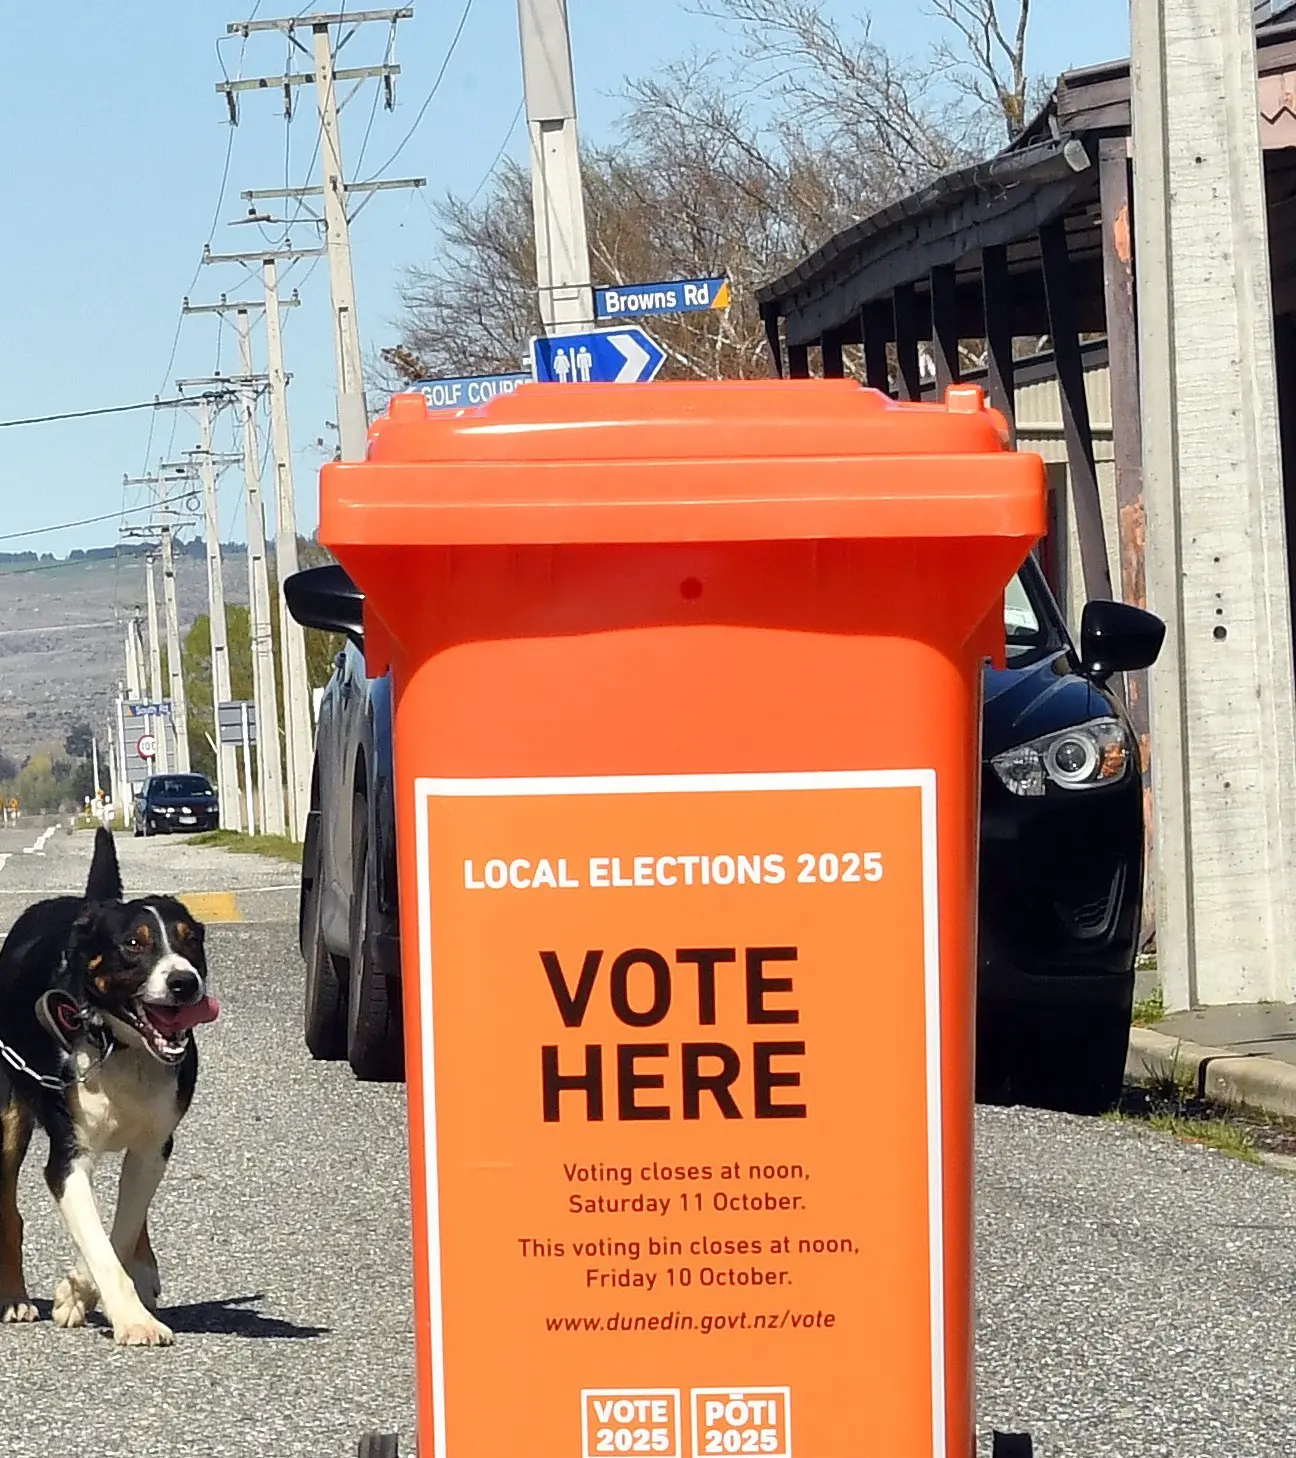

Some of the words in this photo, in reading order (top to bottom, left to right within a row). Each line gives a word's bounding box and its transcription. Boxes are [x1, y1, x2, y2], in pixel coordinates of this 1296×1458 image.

[605, 291, 676, 313] Browns
[684, 284, 709, 305] Rd
[421, 384, 461, 406] GOLF
[464, 858, 580, 889] LOCAL
[589, 854, 786, 888] ELECTIONS
[797, 852, 883, 883] 2025
[539, 946, 800, 1028] VOTE
[542, 1041, 807, 1123] HERE
[563, 1162, 632, 1186] Voting
[640, 1161, 713, 1181] closes
[720, 1161, 741, 1180] at
[749, 1164, 810, 1182] noon,
[569, 1193, 671, 1217] Saturday
[679, 1192, 702, 1212] 11
[713, 1191, 806, 1212] October.
[517, 1238, 565, 1258] This
[572, 1237, 641, 1261] voting
[648, 1236, 682, 1256] bin
[689, 1235, 763, 1255] closes
[769, 1236, 791, 1254] at
[798, 1238, 859, 1256] noon,
[586, 1268, 658, 1292] Friday
[666, 1267, 692, 1287] 10
[699, 1266, 792, 1287] October.
[545, 1310, 836, 1335] www.dunedin.govt.nz/vote
[593, 1400, 669, 1424] VOTE
[705, 1393, 777, 1427] PŌTI
[596, 1428, 670, 1452] 2025
[705, 1429, 779, 1453] 2025
